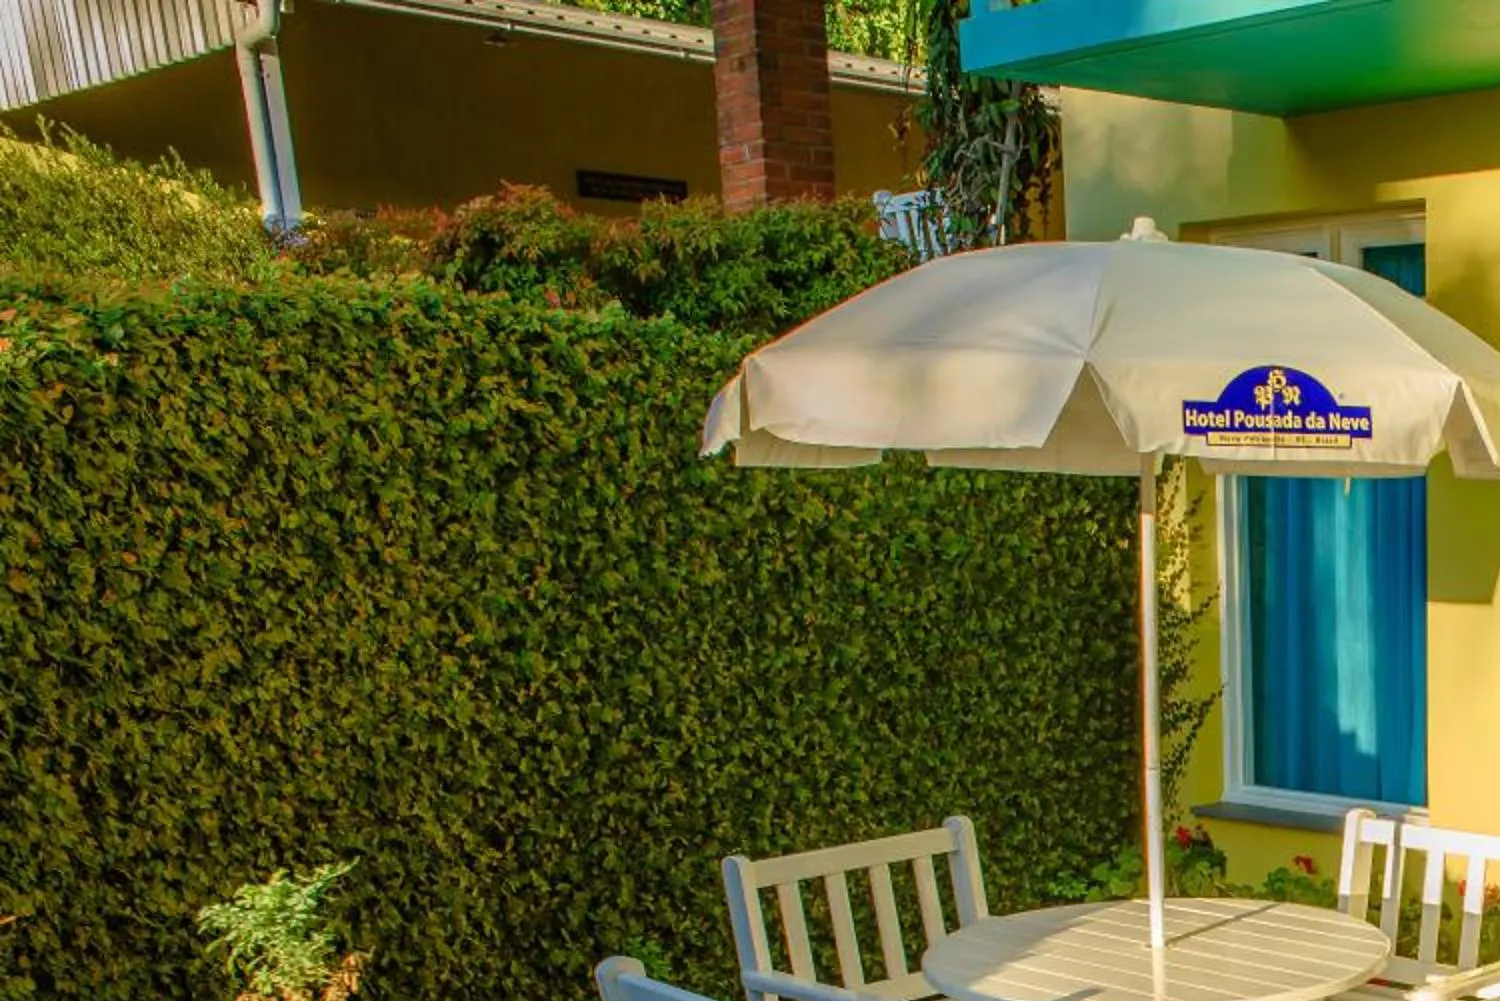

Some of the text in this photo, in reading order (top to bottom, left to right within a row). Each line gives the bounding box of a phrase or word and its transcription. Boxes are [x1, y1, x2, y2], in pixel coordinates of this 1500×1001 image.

[1185, 409, 1370, 431] Hotel Pousada da Neve
